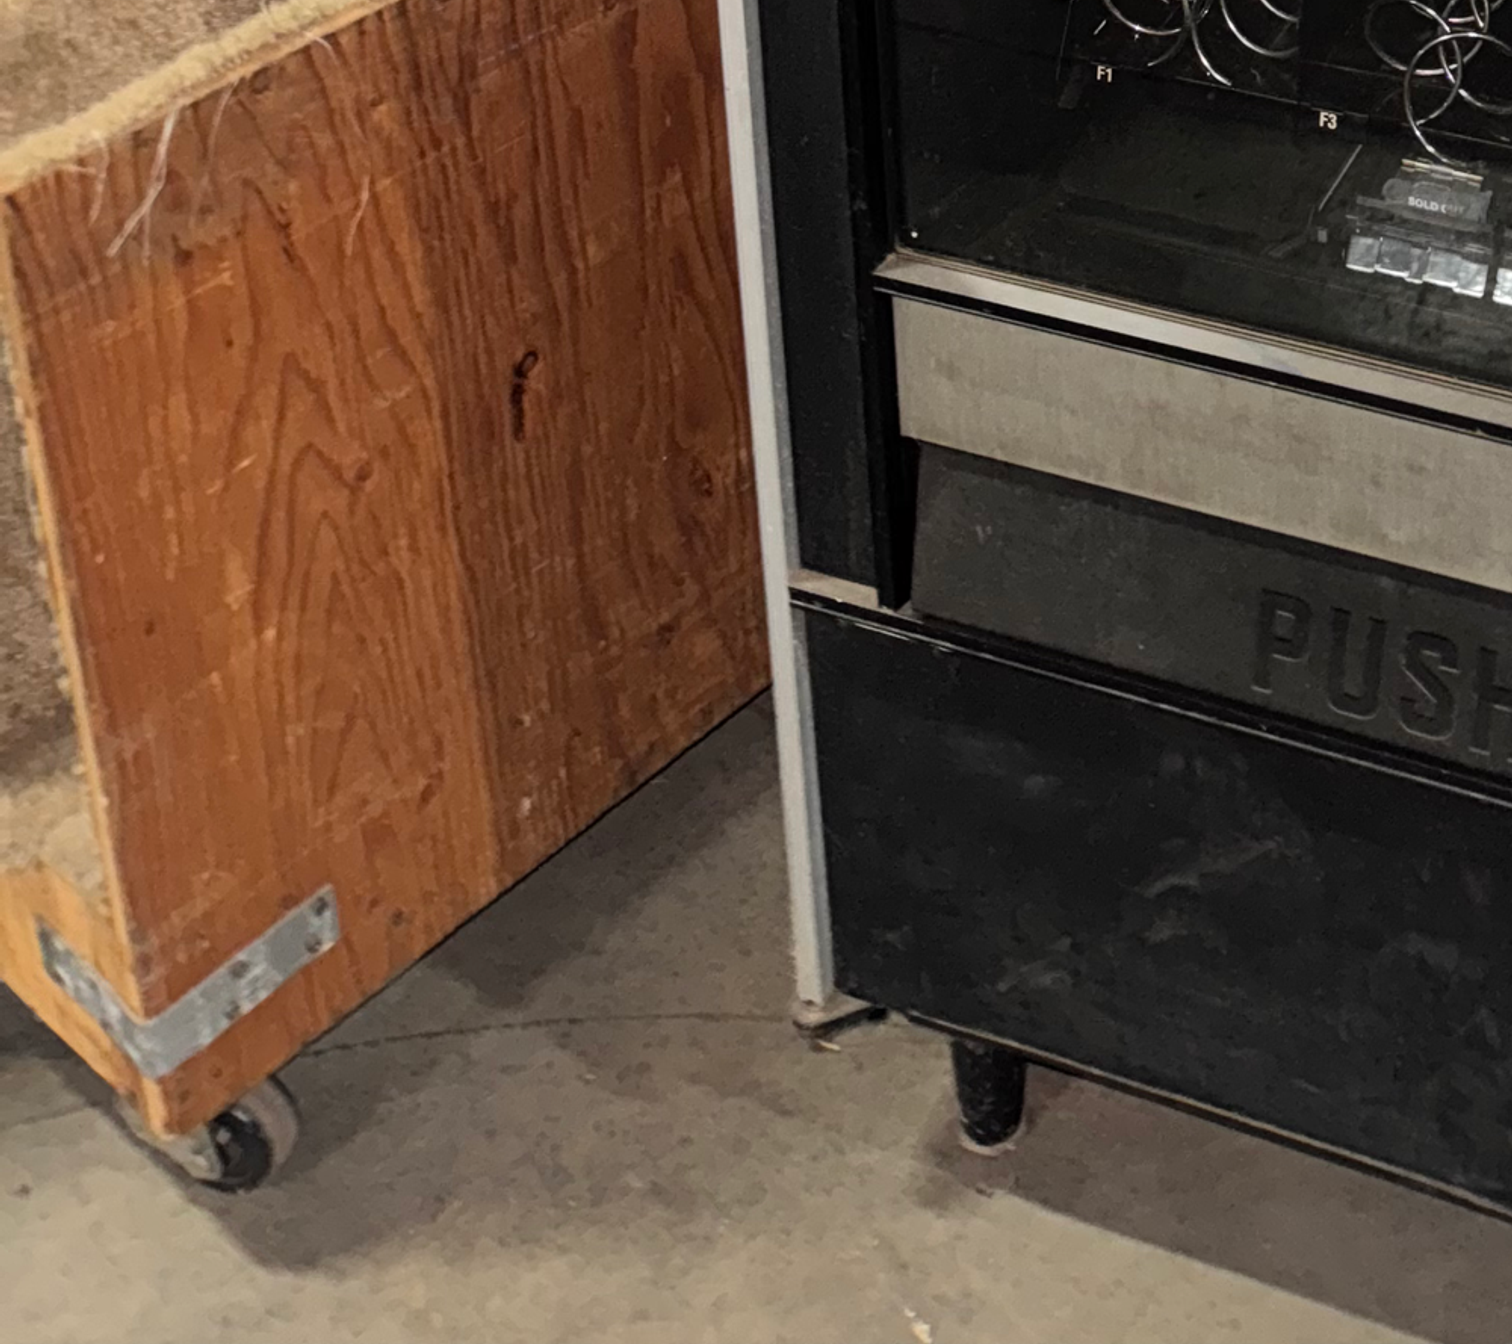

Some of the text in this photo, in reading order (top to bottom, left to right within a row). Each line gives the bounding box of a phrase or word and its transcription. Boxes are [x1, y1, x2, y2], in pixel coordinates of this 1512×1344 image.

[1097, 65, 1114, 83] F1
[1319, 113, 1338, 130] F3
[1407, 196, 1439, 212] SOLD
